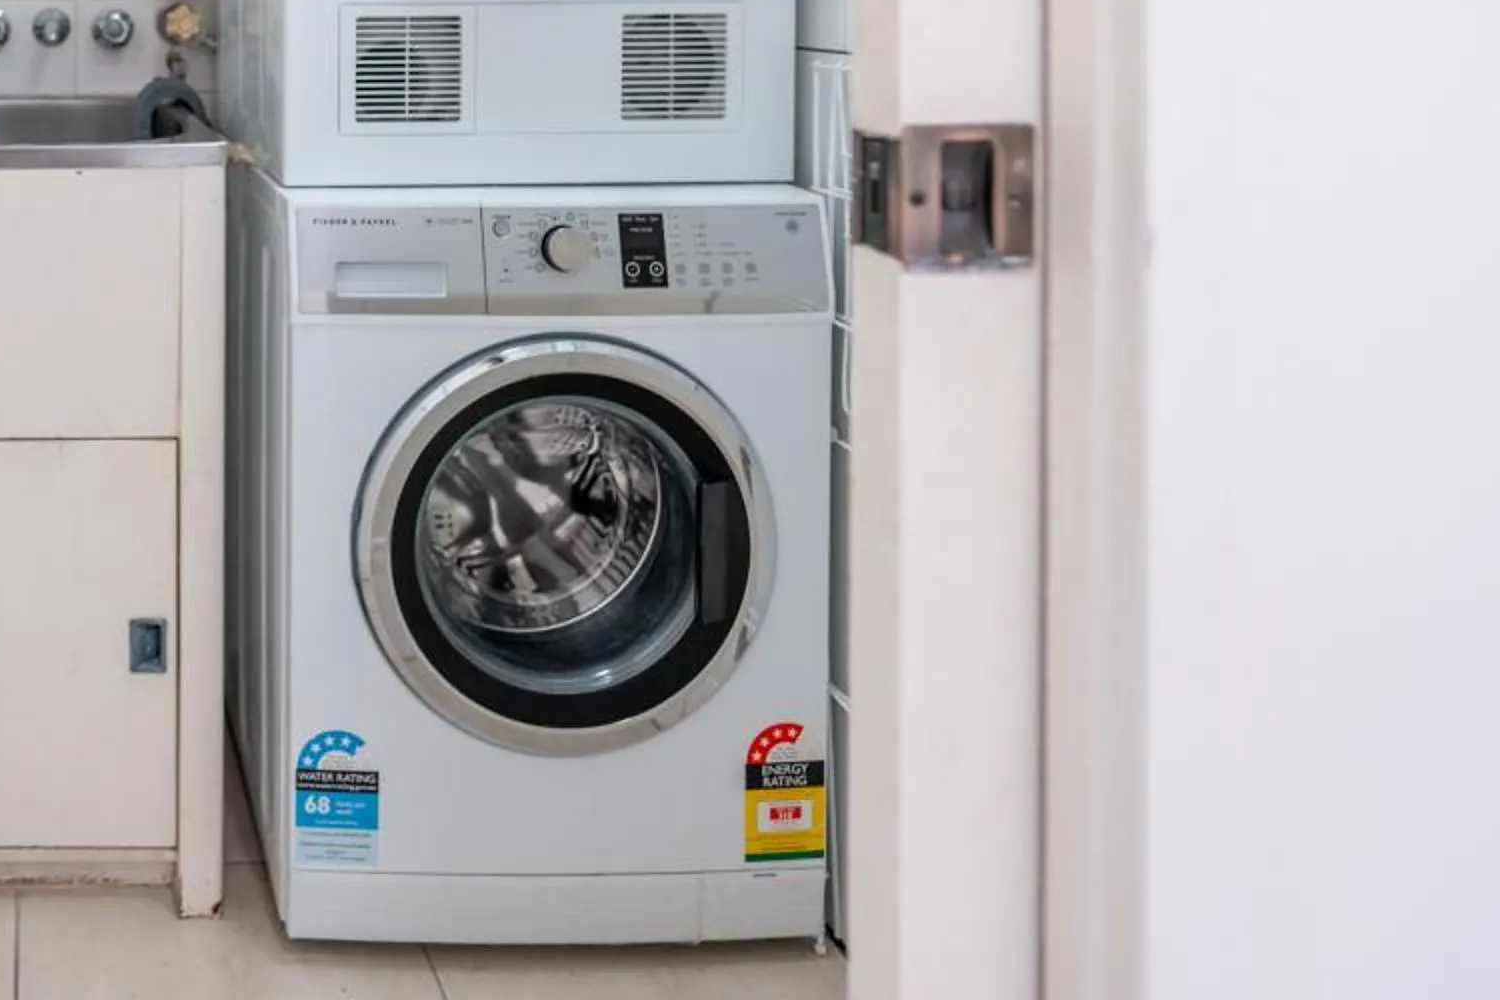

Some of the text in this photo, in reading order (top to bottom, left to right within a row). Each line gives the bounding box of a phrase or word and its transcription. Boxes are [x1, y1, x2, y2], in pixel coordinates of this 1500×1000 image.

[761, 763, 809, 776] ENERGY
[298, 772, 377, 784] WATER RATING
[763, 775, 808, 788] RATING
[303, 795, 331, 815] 68
